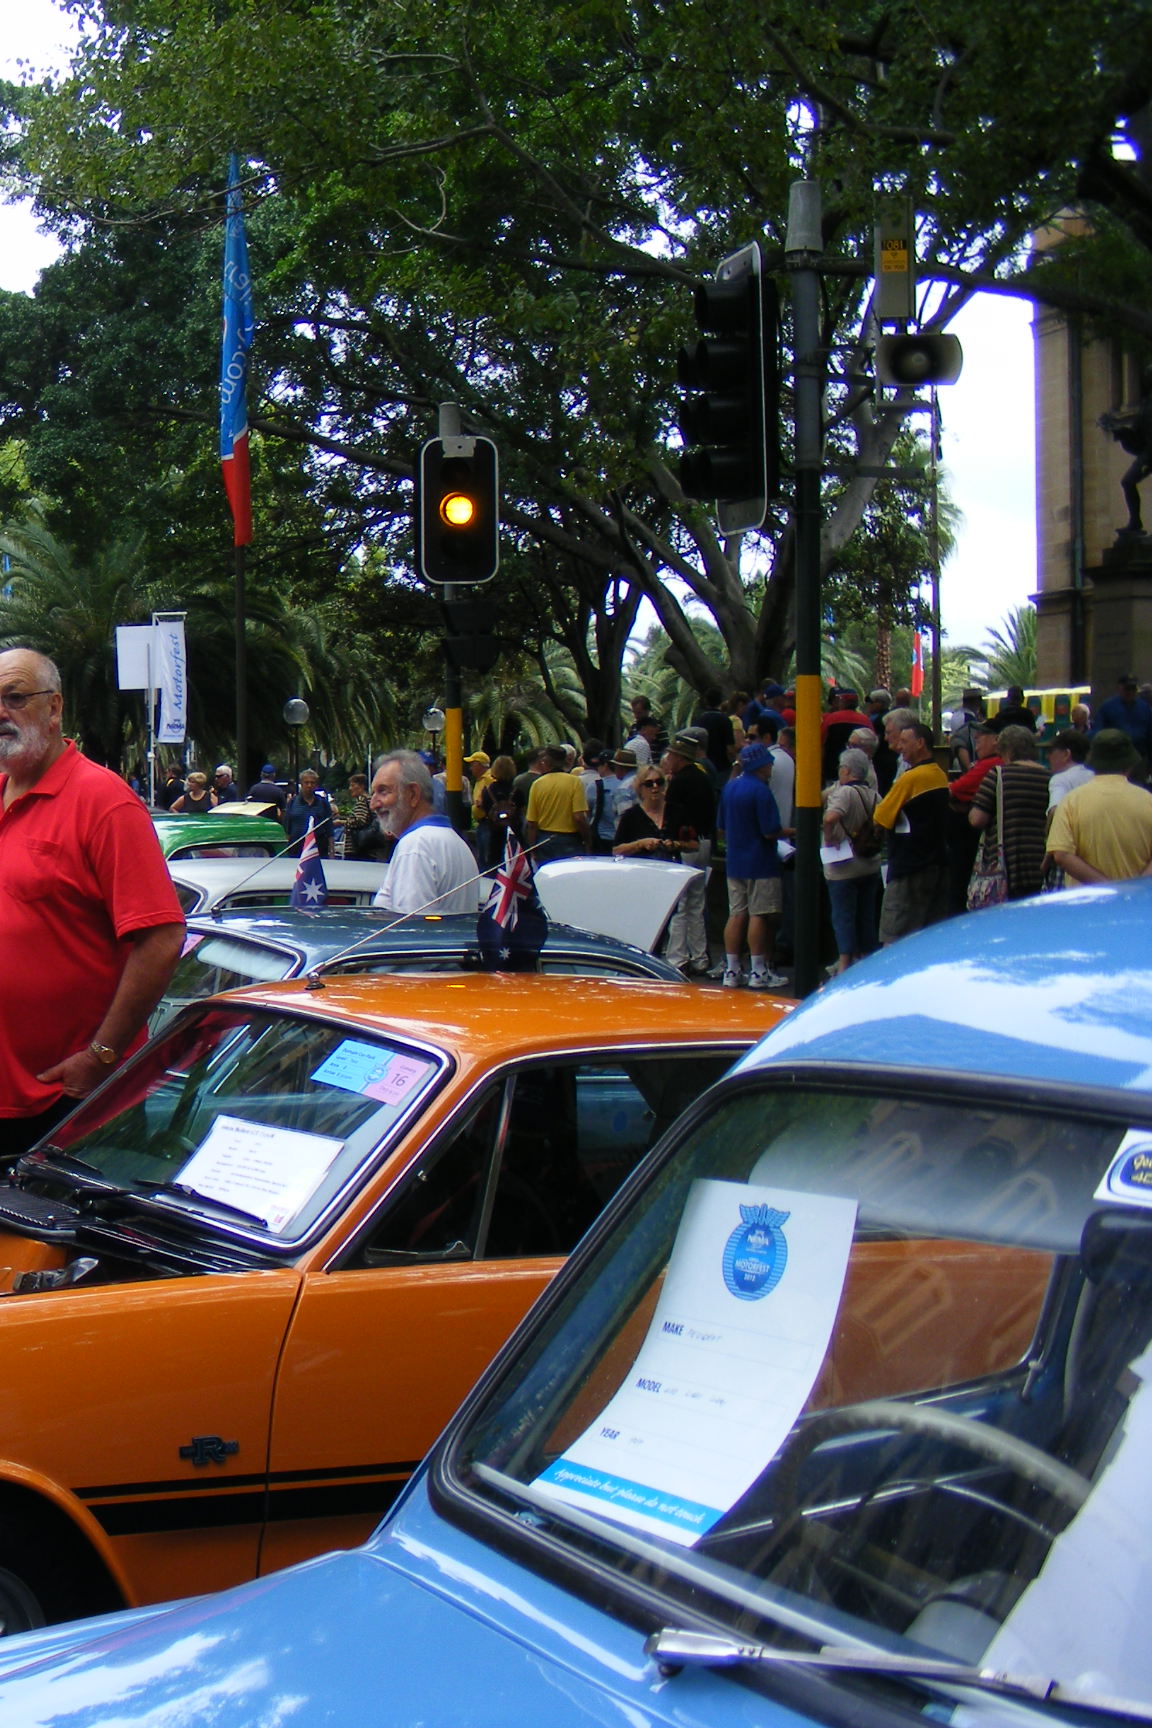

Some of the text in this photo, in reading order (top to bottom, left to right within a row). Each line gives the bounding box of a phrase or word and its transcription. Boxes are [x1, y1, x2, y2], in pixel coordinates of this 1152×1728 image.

[169, 633, 185, 710] Motorfest
[391, 1073, 408, 1087] 16
[662, 1321, 685, 1336] MAKE
[635, 1378, 663, 1393] MODEL
[600, 1427, 621, 1440] YEAR
